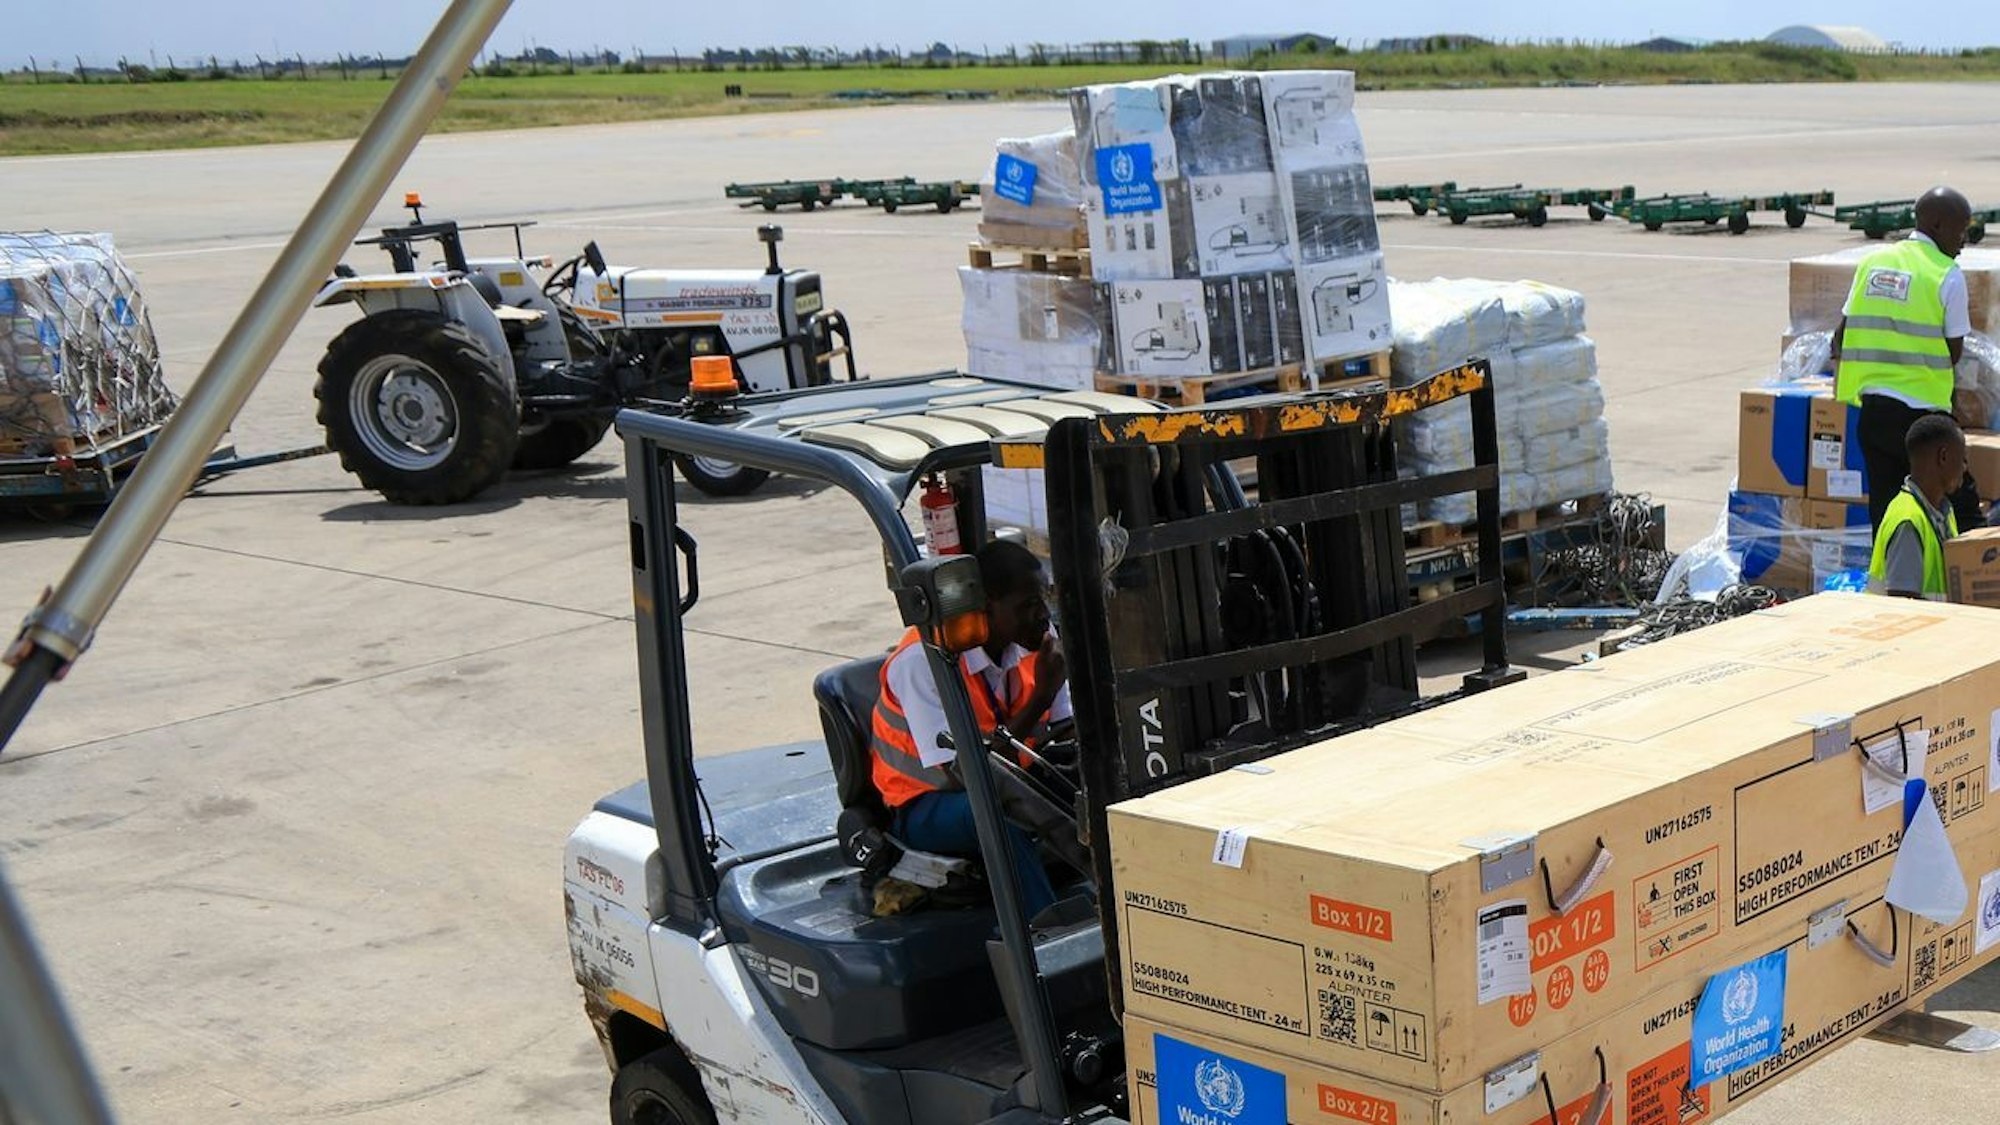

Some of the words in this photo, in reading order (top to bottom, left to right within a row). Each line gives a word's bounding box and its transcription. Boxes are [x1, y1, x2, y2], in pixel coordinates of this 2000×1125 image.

[1110, 186, 1128, 196] World
[1129, 183, 1150, 194] Health
[1110, 195, 1153, 209] Organization
[1646, 805, 1712, 844] UN27162575
[1674, 861, 1704, 887] FIRST
[1738, 893, 1768, 918] HIGH
[1771, 852, 1852, 902] PERFORMANCE
[1855, 839, 1881, 863] TENT
[1887, 830, 1900, 849] 24
[1739, 850, 1804, 894] S5088024
[1125, 890, 1188, 915] UN27162575
[1673, 881, 1700, 902] OPEN
[1674, 899, 1695, 918] THIS
[1696, 889, 1716, 908] BOX
[1317, 902, 1351, 927] Box
[1356, 911, 1385, 935] 1/2
[1571, 908, 1603, 942] 1/2
[768, 957, 820, 998] 30
[1134, 961, 1190, 986] S5088024
[1315, 962, 1333, 976] 225
[1335, 968, 1341, 978] x
[1343, 970, 1355, 981] 69
[1358, 974, 1364, 984] x
[1366, 975, 1377, 987] 35
[1380, 979, 1396, 991] cm
[1586, 965, 1607, 989] 3/6
[1134, 977, 1160, 994] HIGH
[1161, 985, 1239, 1014] PERFORMANCE
[1240, 1005, 1267, 1022] TENT
[1274, 1013, 1289, 1028] 24
[1328, 980, 1392, 1005] ALPINTER
[1550, 981, 1572, 1005] 2/6
[1512, 997, 1534, 1021] 1/6
[1644, 995, 1701, 1036] UN271625
[1705, 1028, 1736, 1055] World
[1737, 1015, 1770, 1043] Health
[1732, 1065, 1760, 1094] HIGH
[1763, 1020, 1844, 1076] PERFORMANCE
[1845, 1003, 1871, 1029] TENT
[1877, 992, 1890, 1012] 24
[1703, 1037, 1769, 1075] Organization
[1325, 1090, 1357, 1115] Box
[1361, 1100, 1389, 1123] 2/2
